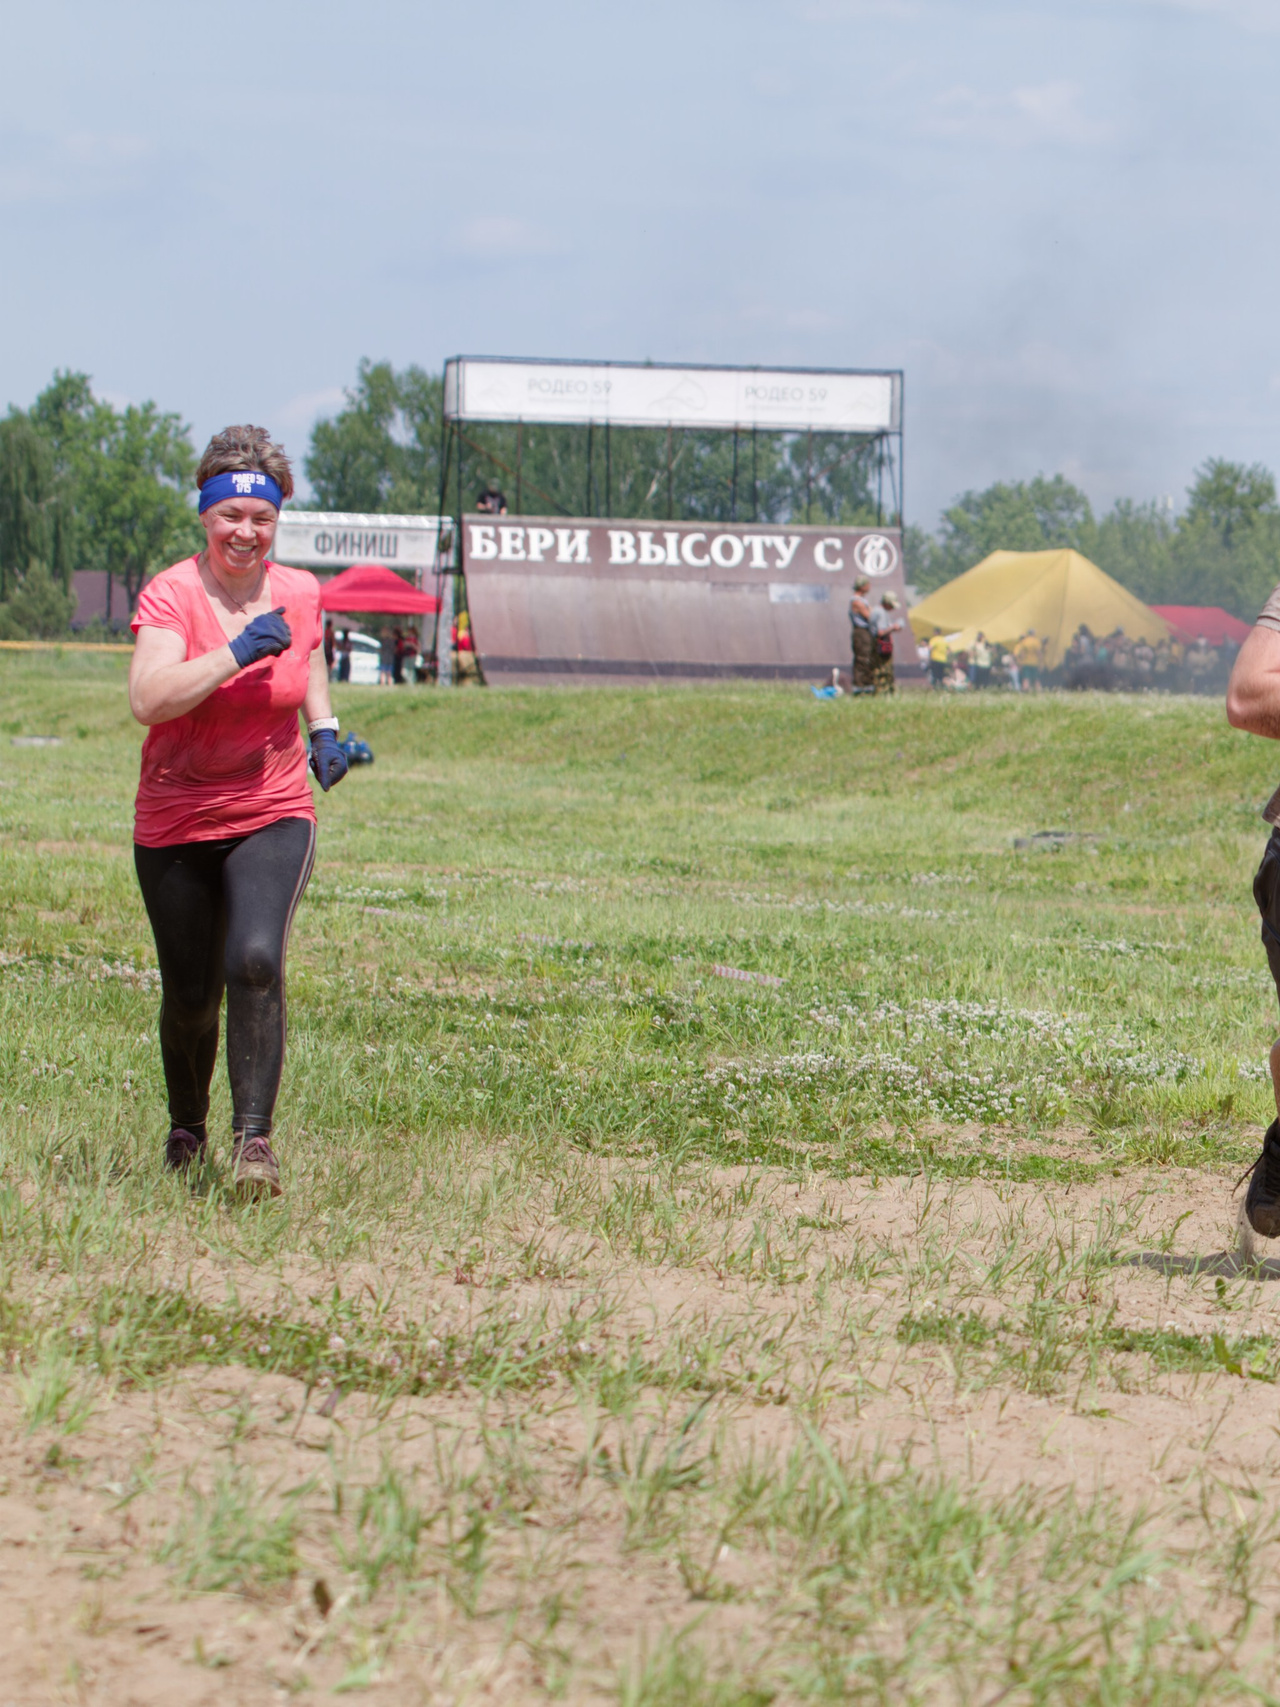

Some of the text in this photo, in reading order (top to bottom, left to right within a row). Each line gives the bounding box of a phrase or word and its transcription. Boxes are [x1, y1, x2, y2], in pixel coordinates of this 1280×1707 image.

[528, 378, 613, 394] РОДЕО 59
[745, 386, 828, 401] РОДЕО 59
[314, 531, 398, 558] ФИНИШ
[468, 525, 592, 563] БЕРИ
[606, 530, 802, 569] ВЫСОТУ
[814, 537, 844, 572] С
